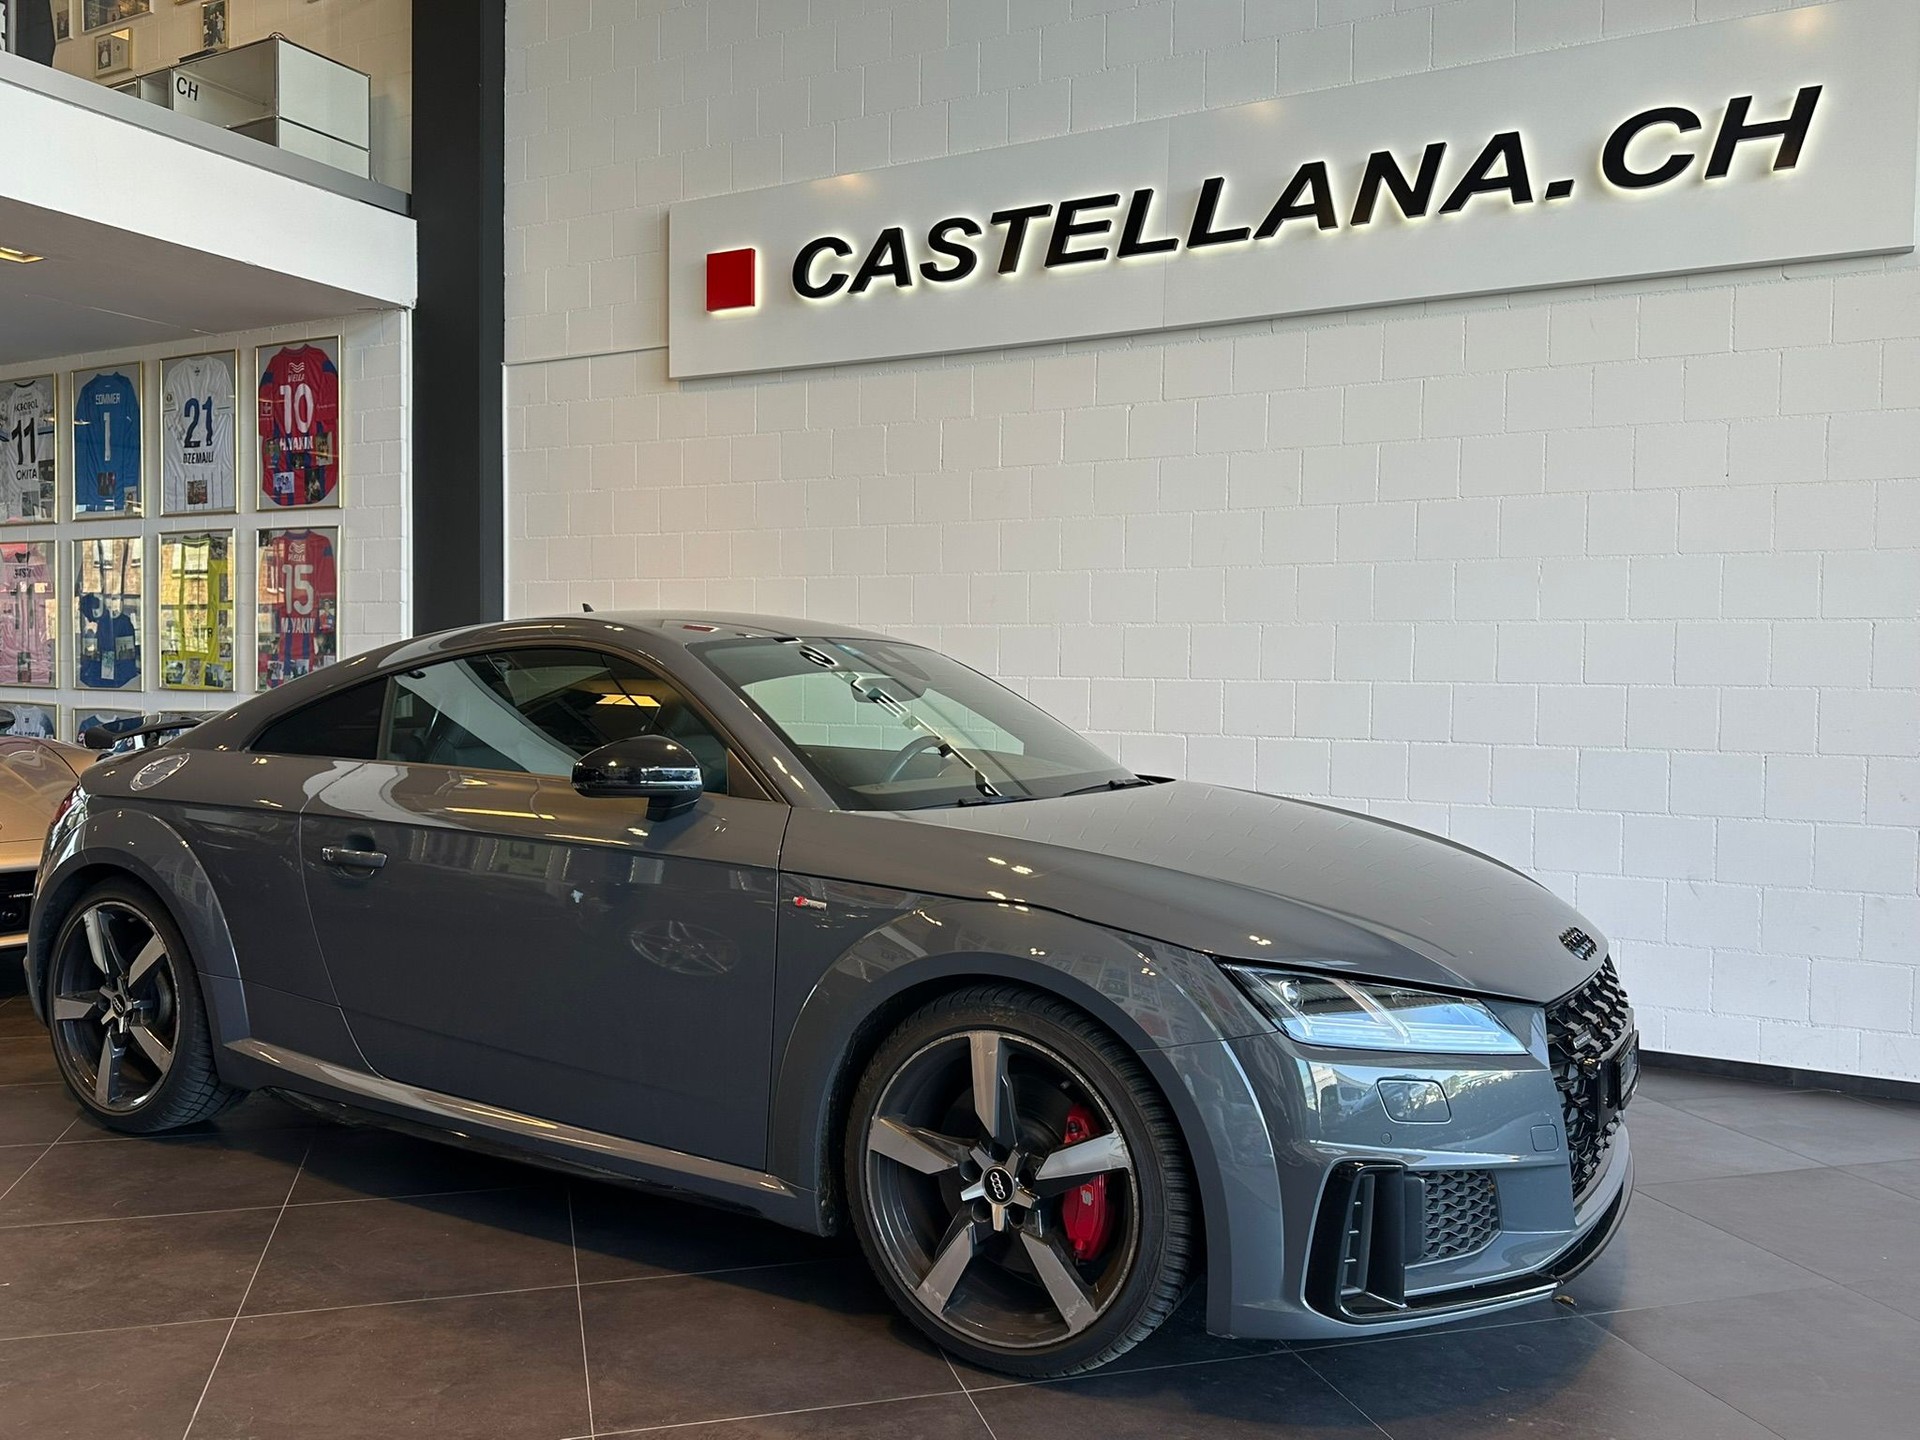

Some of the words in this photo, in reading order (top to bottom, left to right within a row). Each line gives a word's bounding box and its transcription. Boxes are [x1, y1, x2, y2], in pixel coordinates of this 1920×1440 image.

[176, 76, 199, 102] CH
[791, 84, 1824, 299] CASTELLANA.CH
[184, 395, 213, 448] 21
[279, 383, 314, 435] 10
[11, 417, 36, 466] 11
[15, 469, 38, 481] OKITA
[281, 564, 314, 615] 15
